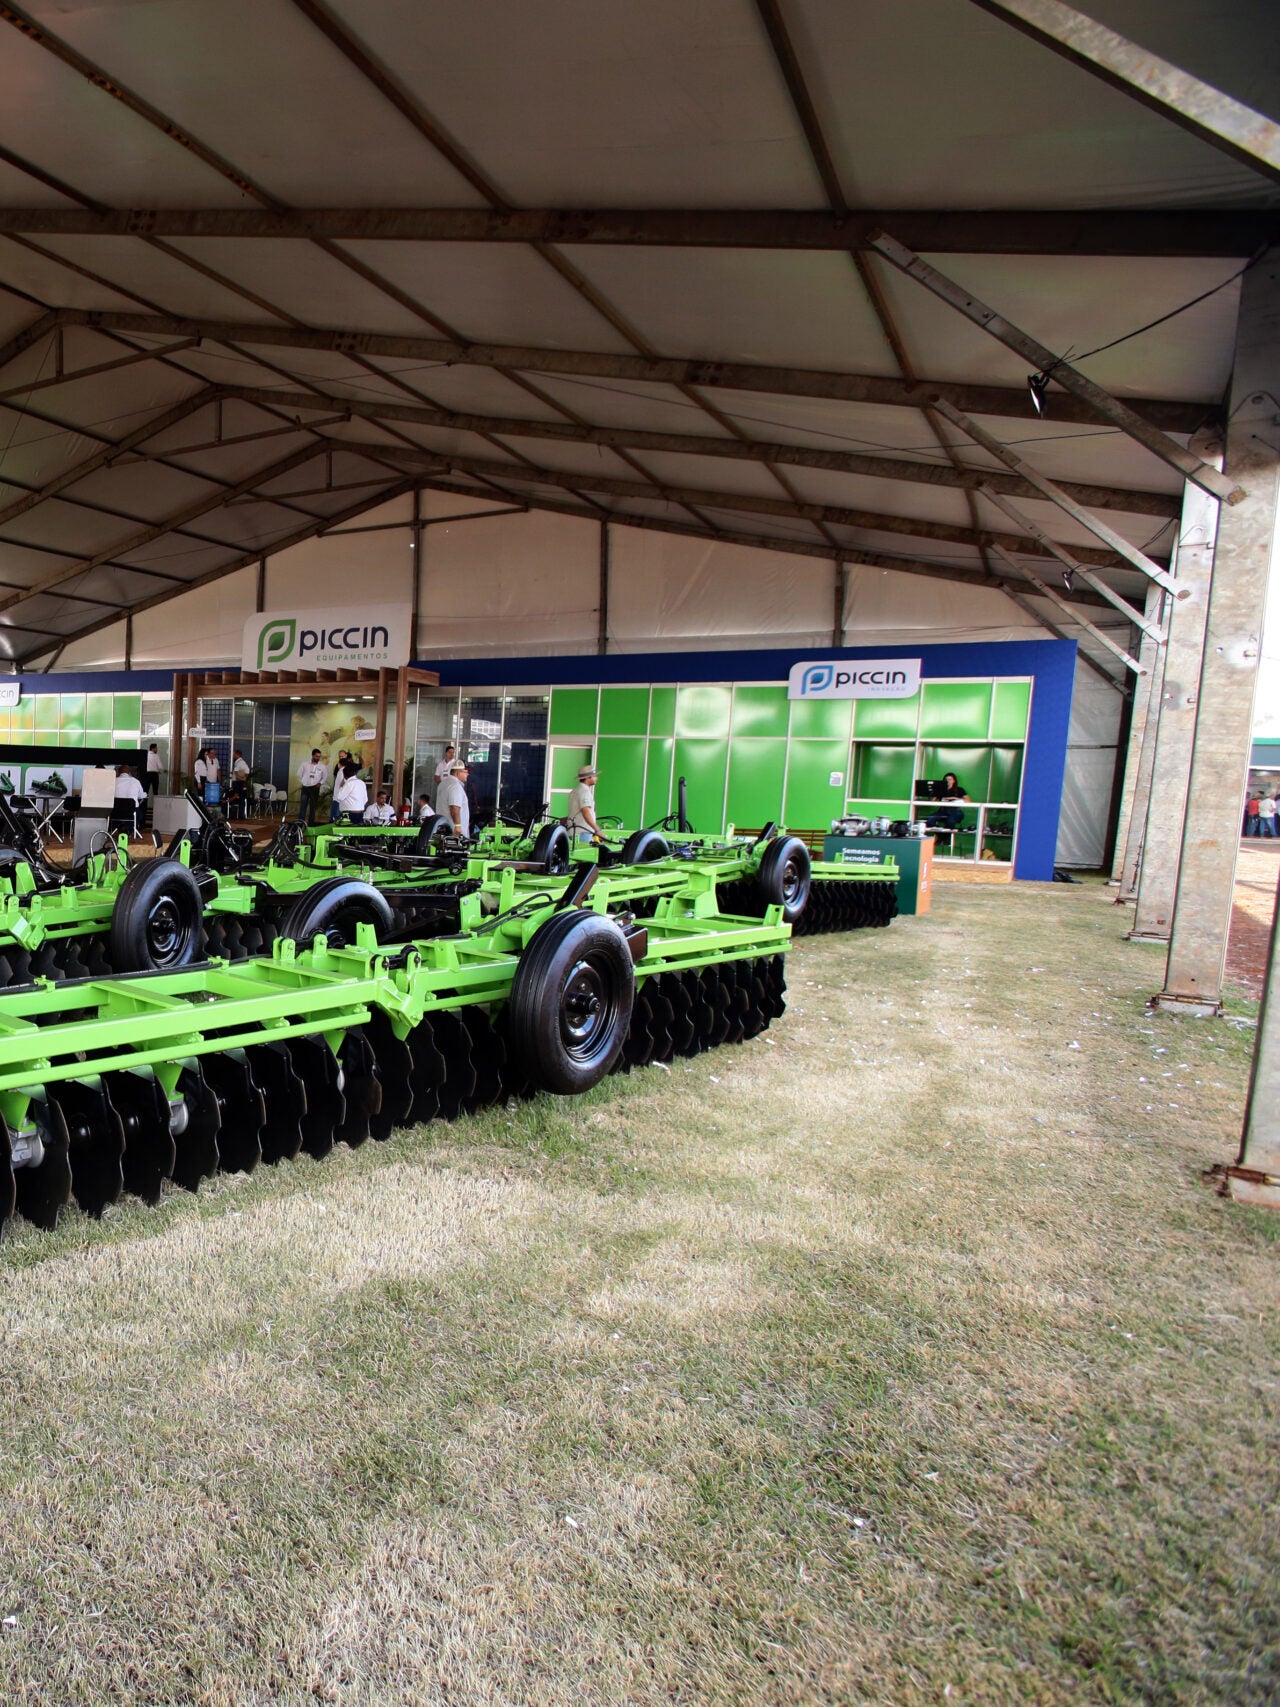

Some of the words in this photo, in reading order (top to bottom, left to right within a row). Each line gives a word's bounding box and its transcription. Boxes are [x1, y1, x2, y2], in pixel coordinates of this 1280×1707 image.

[299, 626, 389, 657] piccin
[316, 653, 388, 661] EQUIPAMENTOS
[835, 671, 906, 688] piccin
[842, 847, 880, 856] Semeamos
[843, 855, 879, 863] ecnologia
